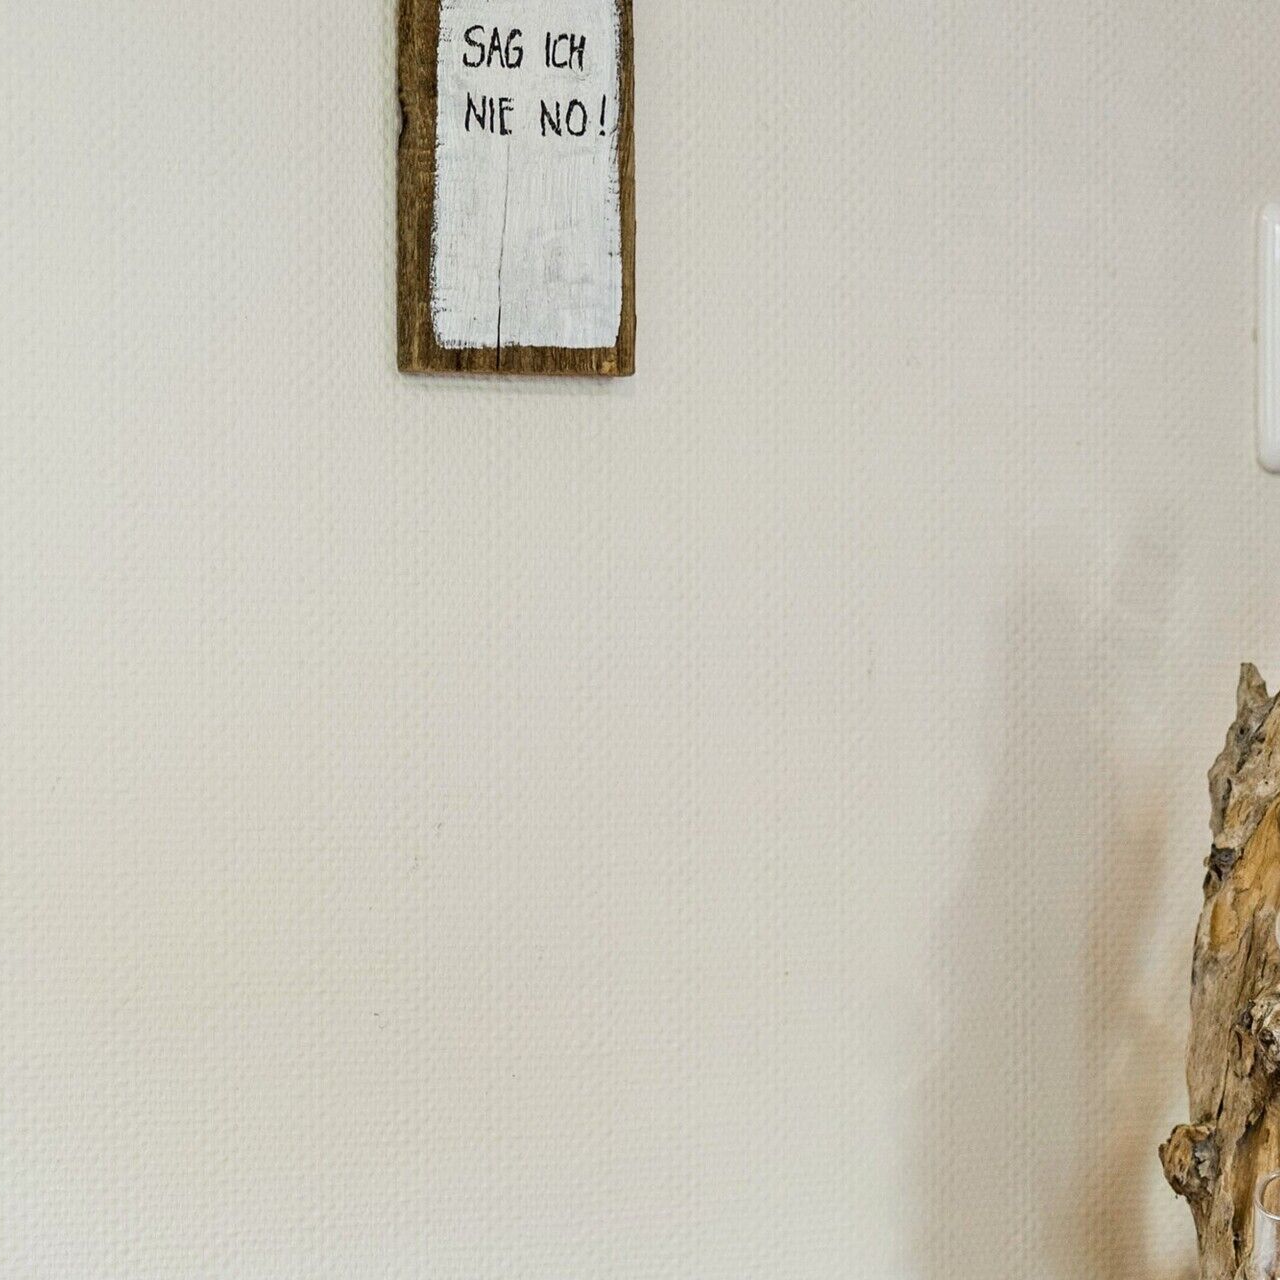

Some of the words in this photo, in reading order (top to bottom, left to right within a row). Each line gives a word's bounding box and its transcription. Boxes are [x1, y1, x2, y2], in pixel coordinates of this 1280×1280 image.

[462, 25, 524, 69] SAG
[544, 31, 587, 72] ICH
[464, 92, 515, 136] NIE
[539, 94, 607, 137] NO!
